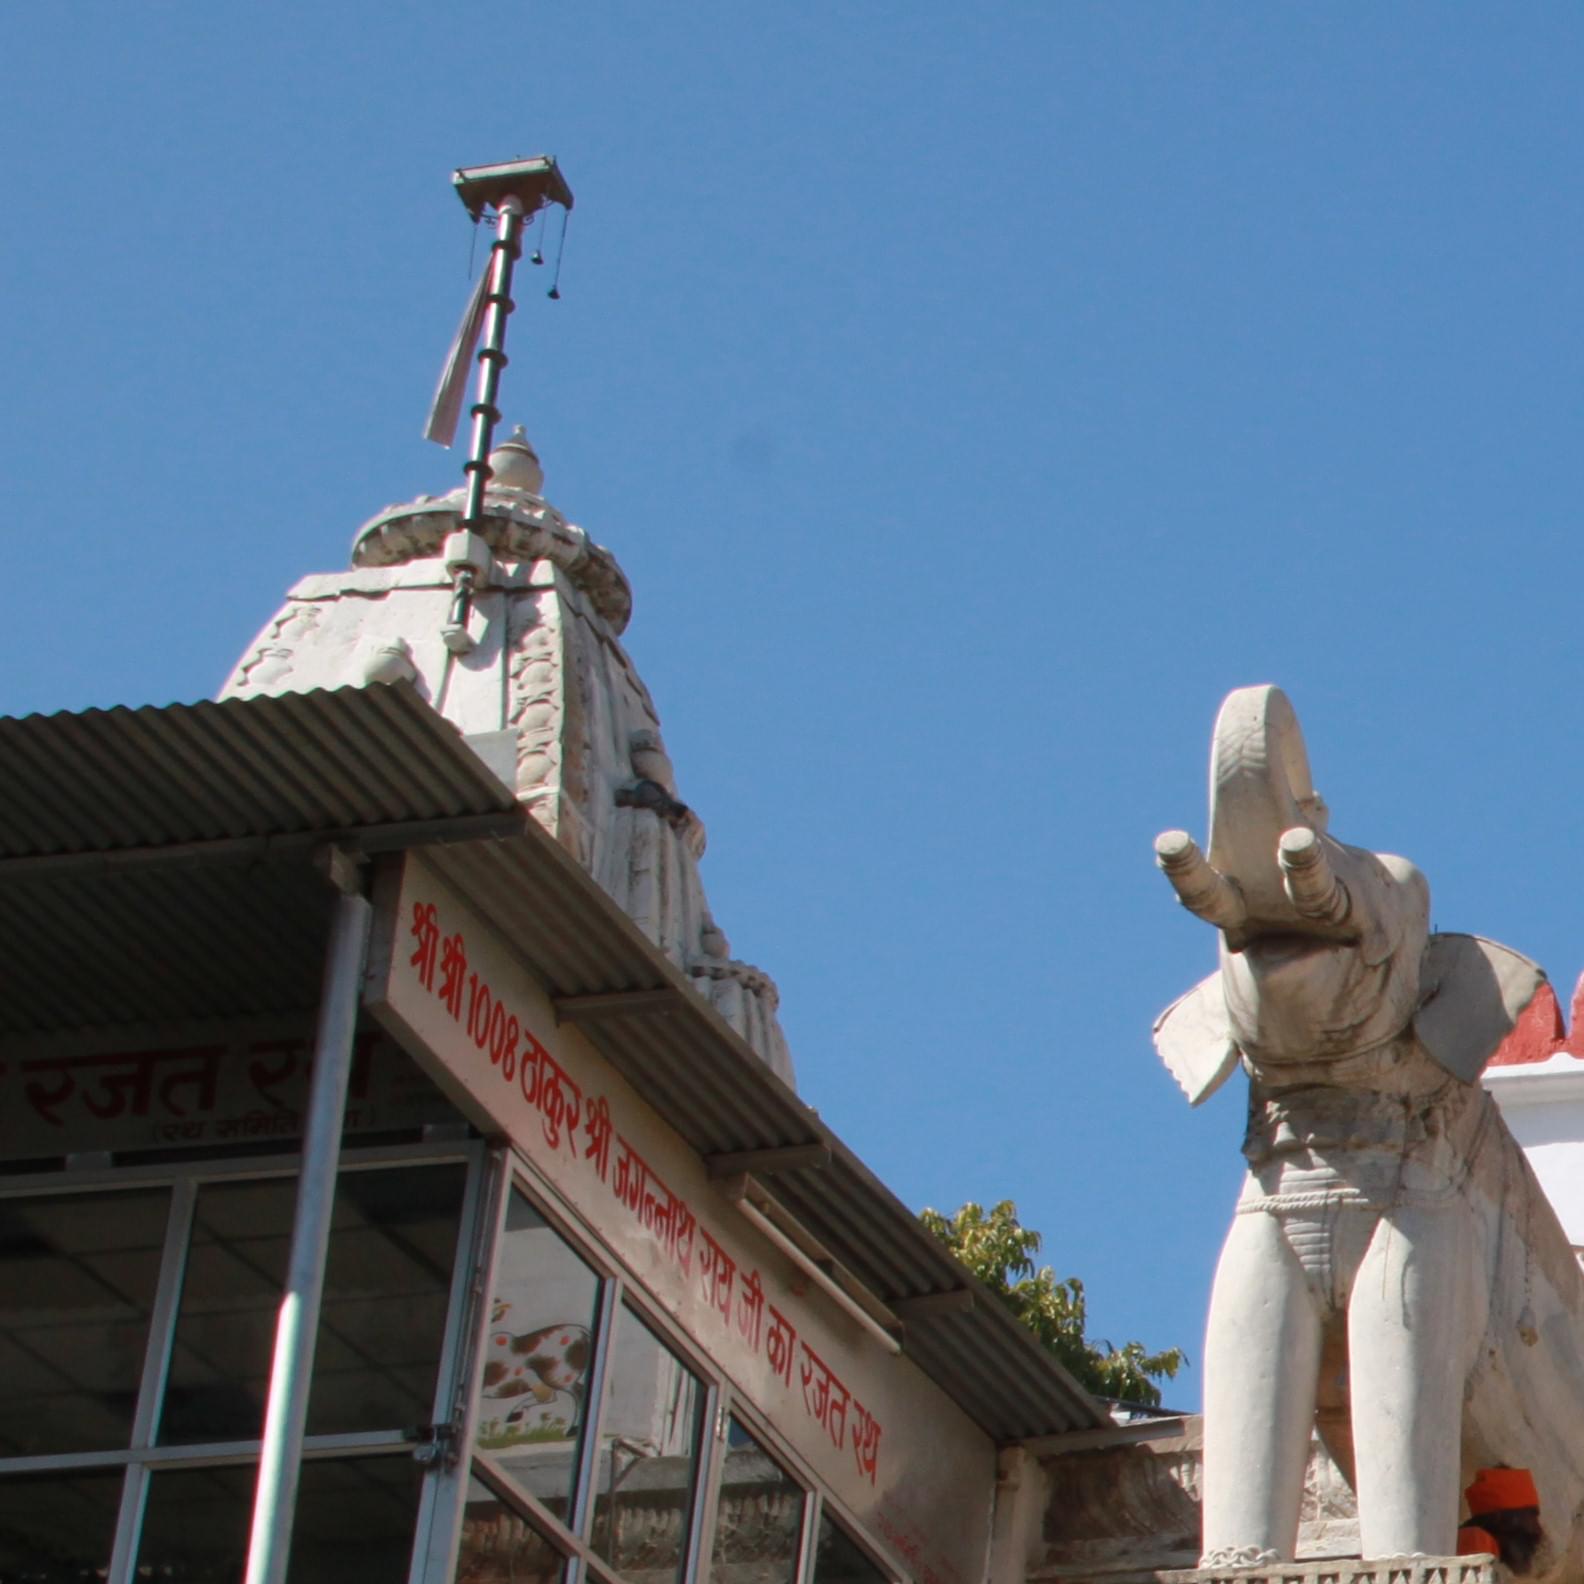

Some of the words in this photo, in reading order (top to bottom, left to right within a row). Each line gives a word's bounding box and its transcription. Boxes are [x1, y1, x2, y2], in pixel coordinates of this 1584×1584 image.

[22, 1043, 227, 1128] रजत
[411, 902, 439, 992] श्री
[438, 933, 467, 1022] श्री
[467, 972, 519, 1082] 1008
[521, 1028, 582, 1158] ठाकुर
[585, 1096, 612, 1182] श्री
[738, 1270, 764, 1353] जी
[767, 1305, 796, 1388] का
[801, 1341, 851, 1449] रजत
[852, 1398, 882, 1487] रथ
